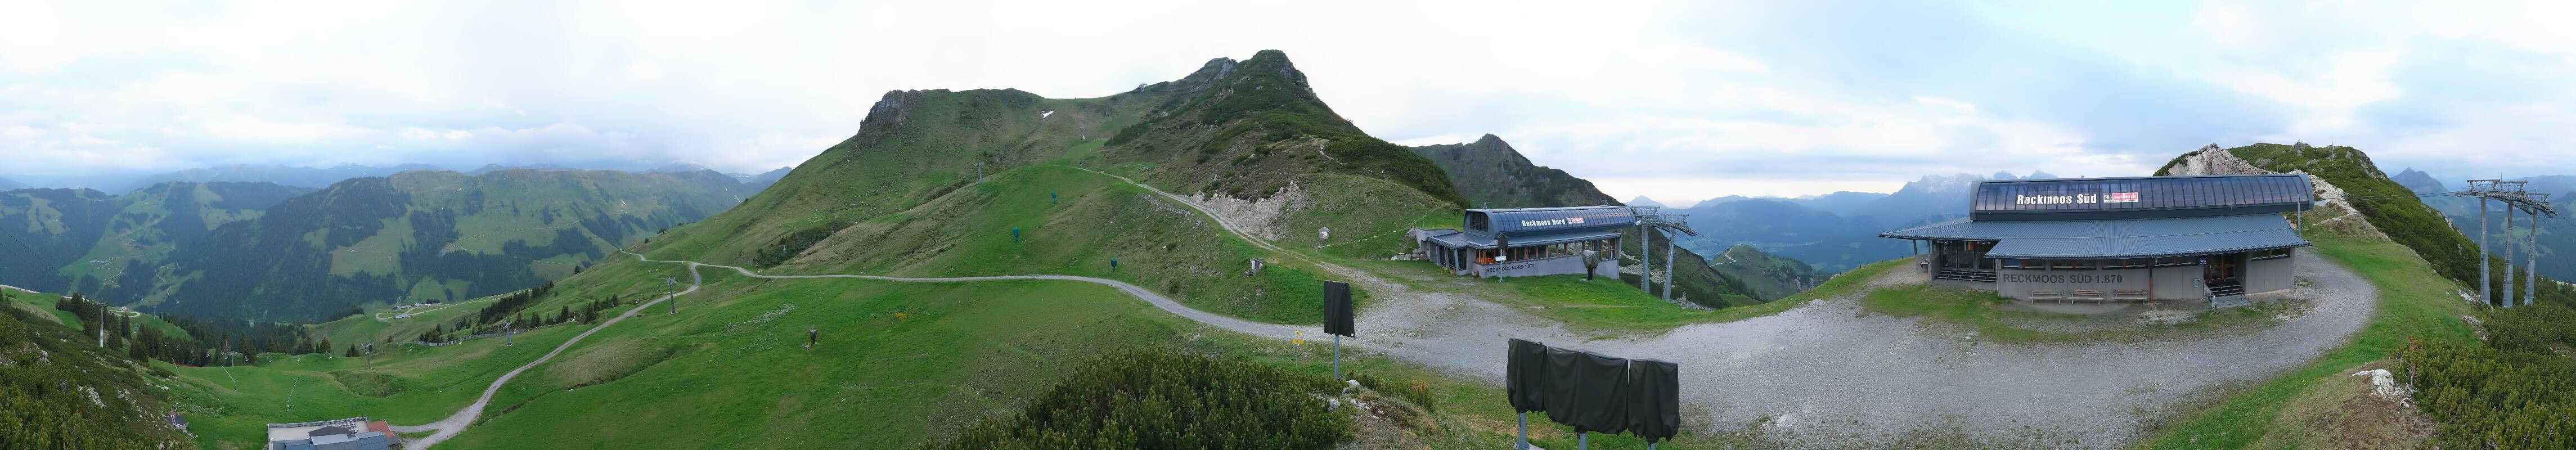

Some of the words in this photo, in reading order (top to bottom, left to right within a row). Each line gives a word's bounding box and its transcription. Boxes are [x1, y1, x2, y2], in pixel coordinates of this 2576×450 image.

[2017, 195, 2073, 205] Reckmoos
[2076, 194, 2097, 204] Süd
[2003, 273, 2065, 284] RECKMOOS
[2070, 273, 2092, 284] SÜD
[2095, 274, 2123, 284] 1.870
